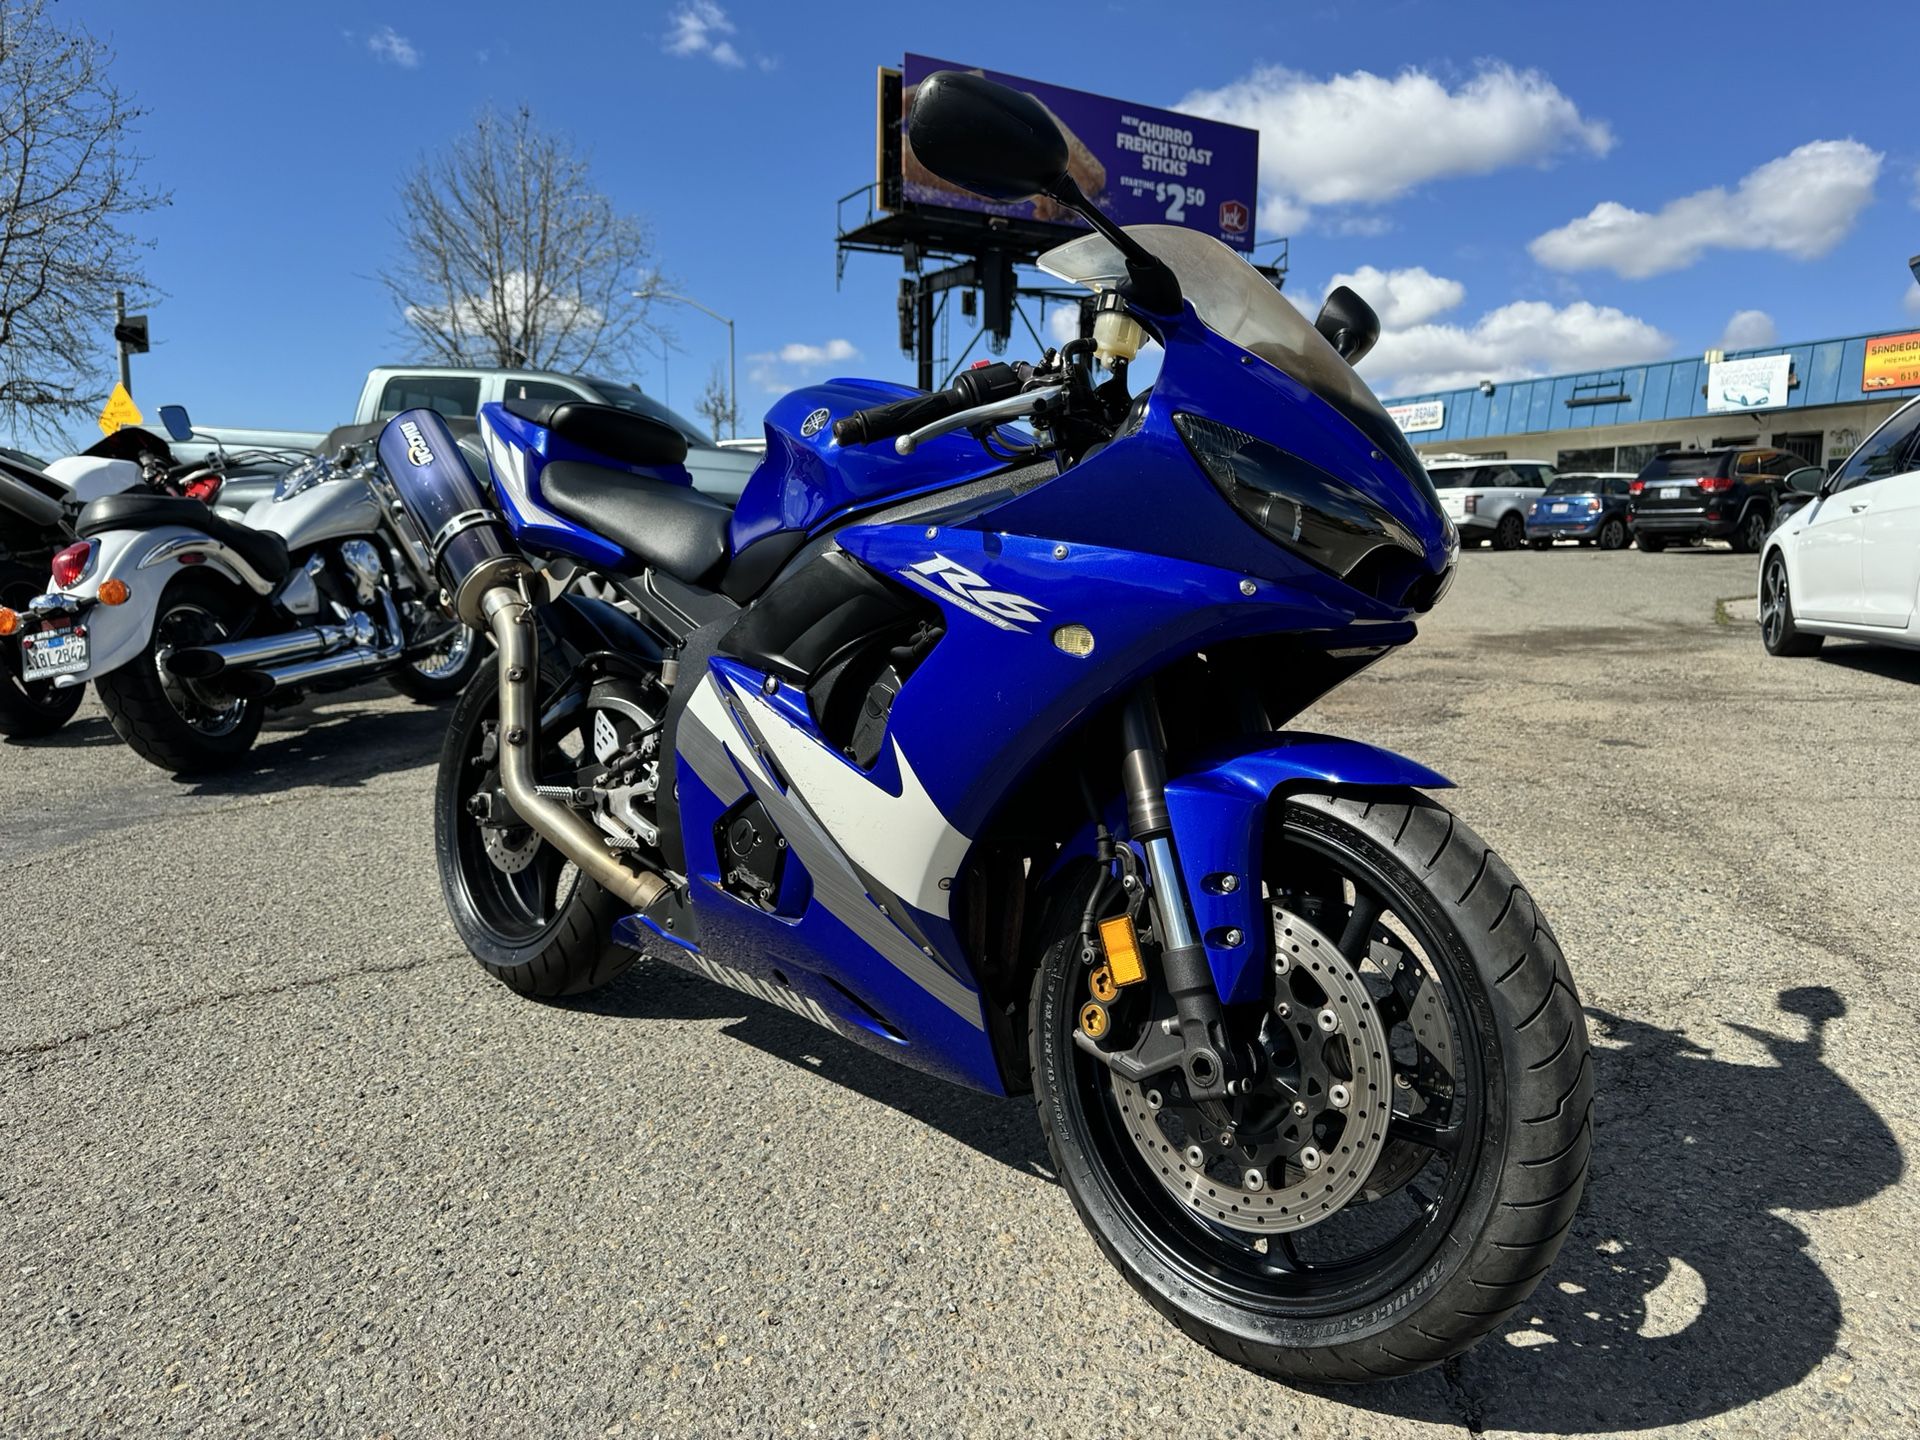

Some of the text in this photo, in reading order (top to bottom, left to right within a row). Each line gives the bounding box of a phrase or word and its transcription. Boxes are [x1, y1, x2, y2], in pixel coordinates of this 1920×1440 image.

[1120, 115, 1193, 146] NEW CHURRO
[1116, 132, 1213, 166] FRENCH TOAST
[1141, 154, 1188, 177] STICKS
[1120, 175, 1156, 190] STARTING
[1871, 341, 1920, 356] SANDIEGO
[909, 551, 1053, 623] R6
